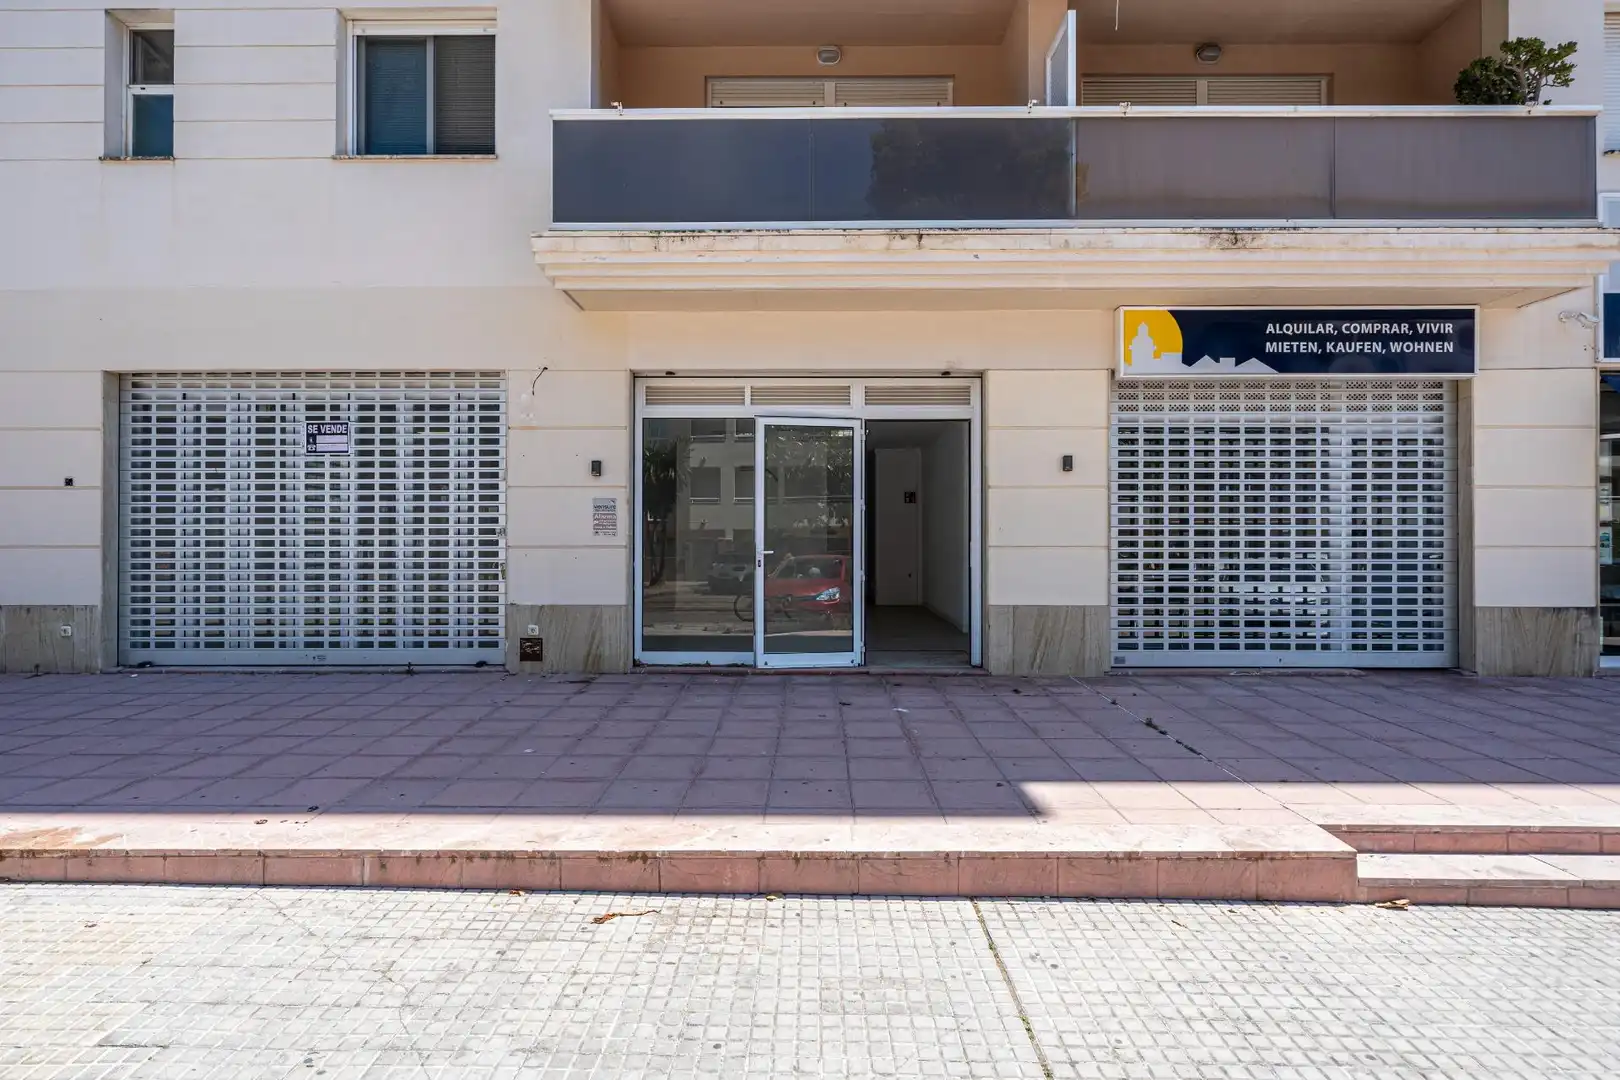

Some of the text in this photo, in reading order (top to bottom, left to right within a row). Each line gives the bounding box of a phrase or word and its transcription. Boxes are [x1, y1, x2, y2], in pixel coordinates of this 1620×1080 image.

[1265, 323, 1454, 336] ALQUILAR, COMPRAR, VIVIR
[1265, 341, 1454, 354] MIETEN, KAUFEN, WOHNEN
[307, 424, 348, 434] SE VENDE
